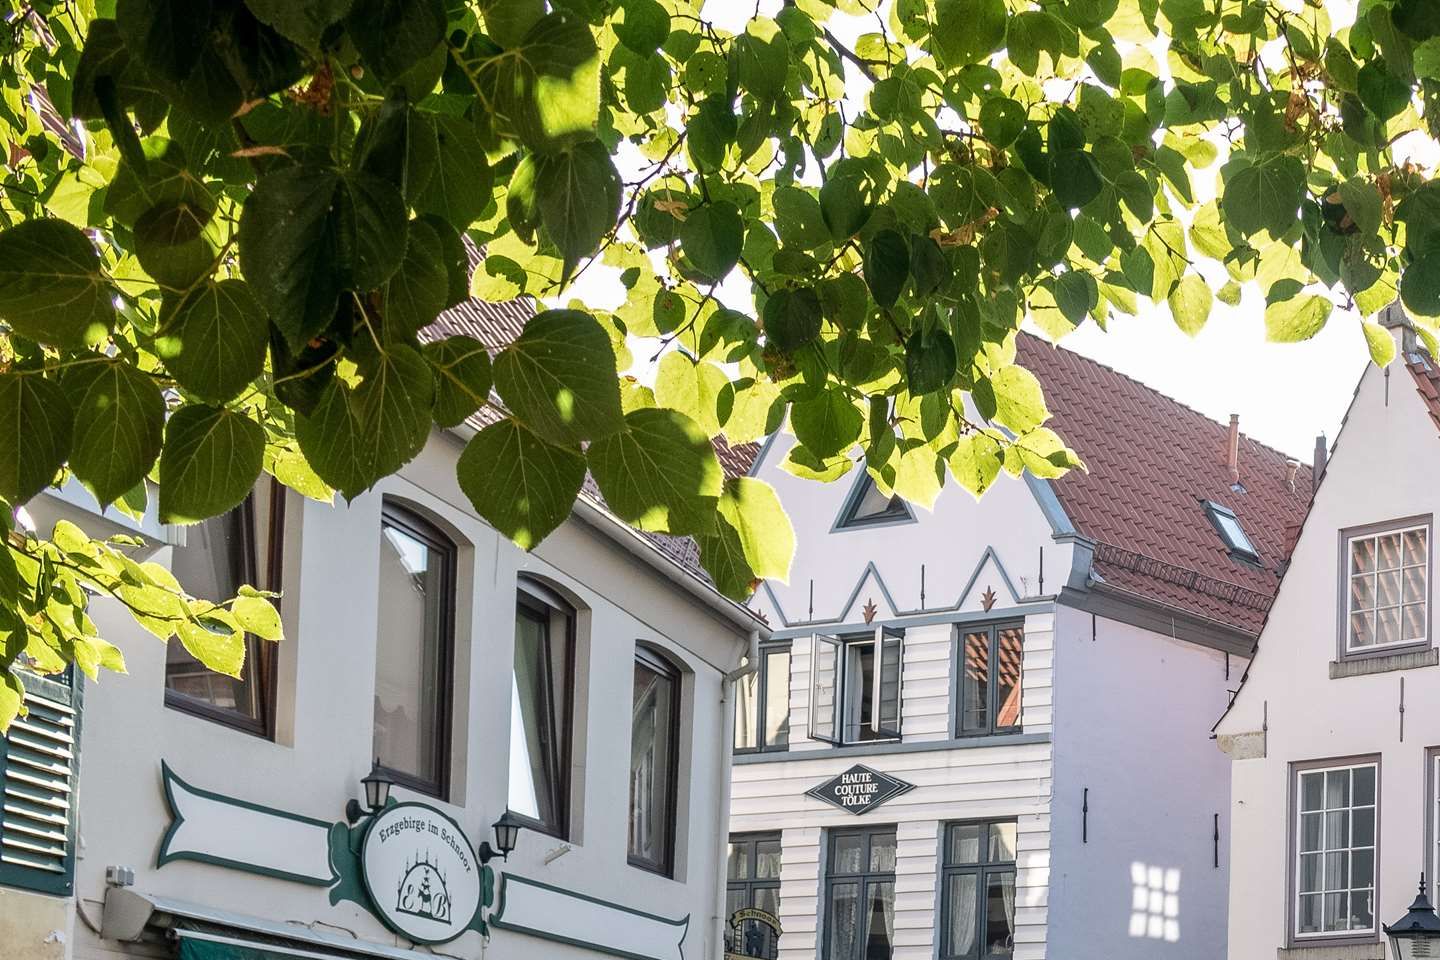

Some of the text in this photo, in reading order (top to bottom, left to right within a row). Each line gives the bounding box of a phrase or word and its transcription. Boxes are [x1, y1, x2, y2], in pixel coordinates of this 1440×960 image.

[841, 773, 873, 784] HAUTE
[834, 783, 879, 796] COUTURE
[841, 793, 872, 806] TÖLKE
[378, 816, 472, 873] Erzgebirge im Schnoor
